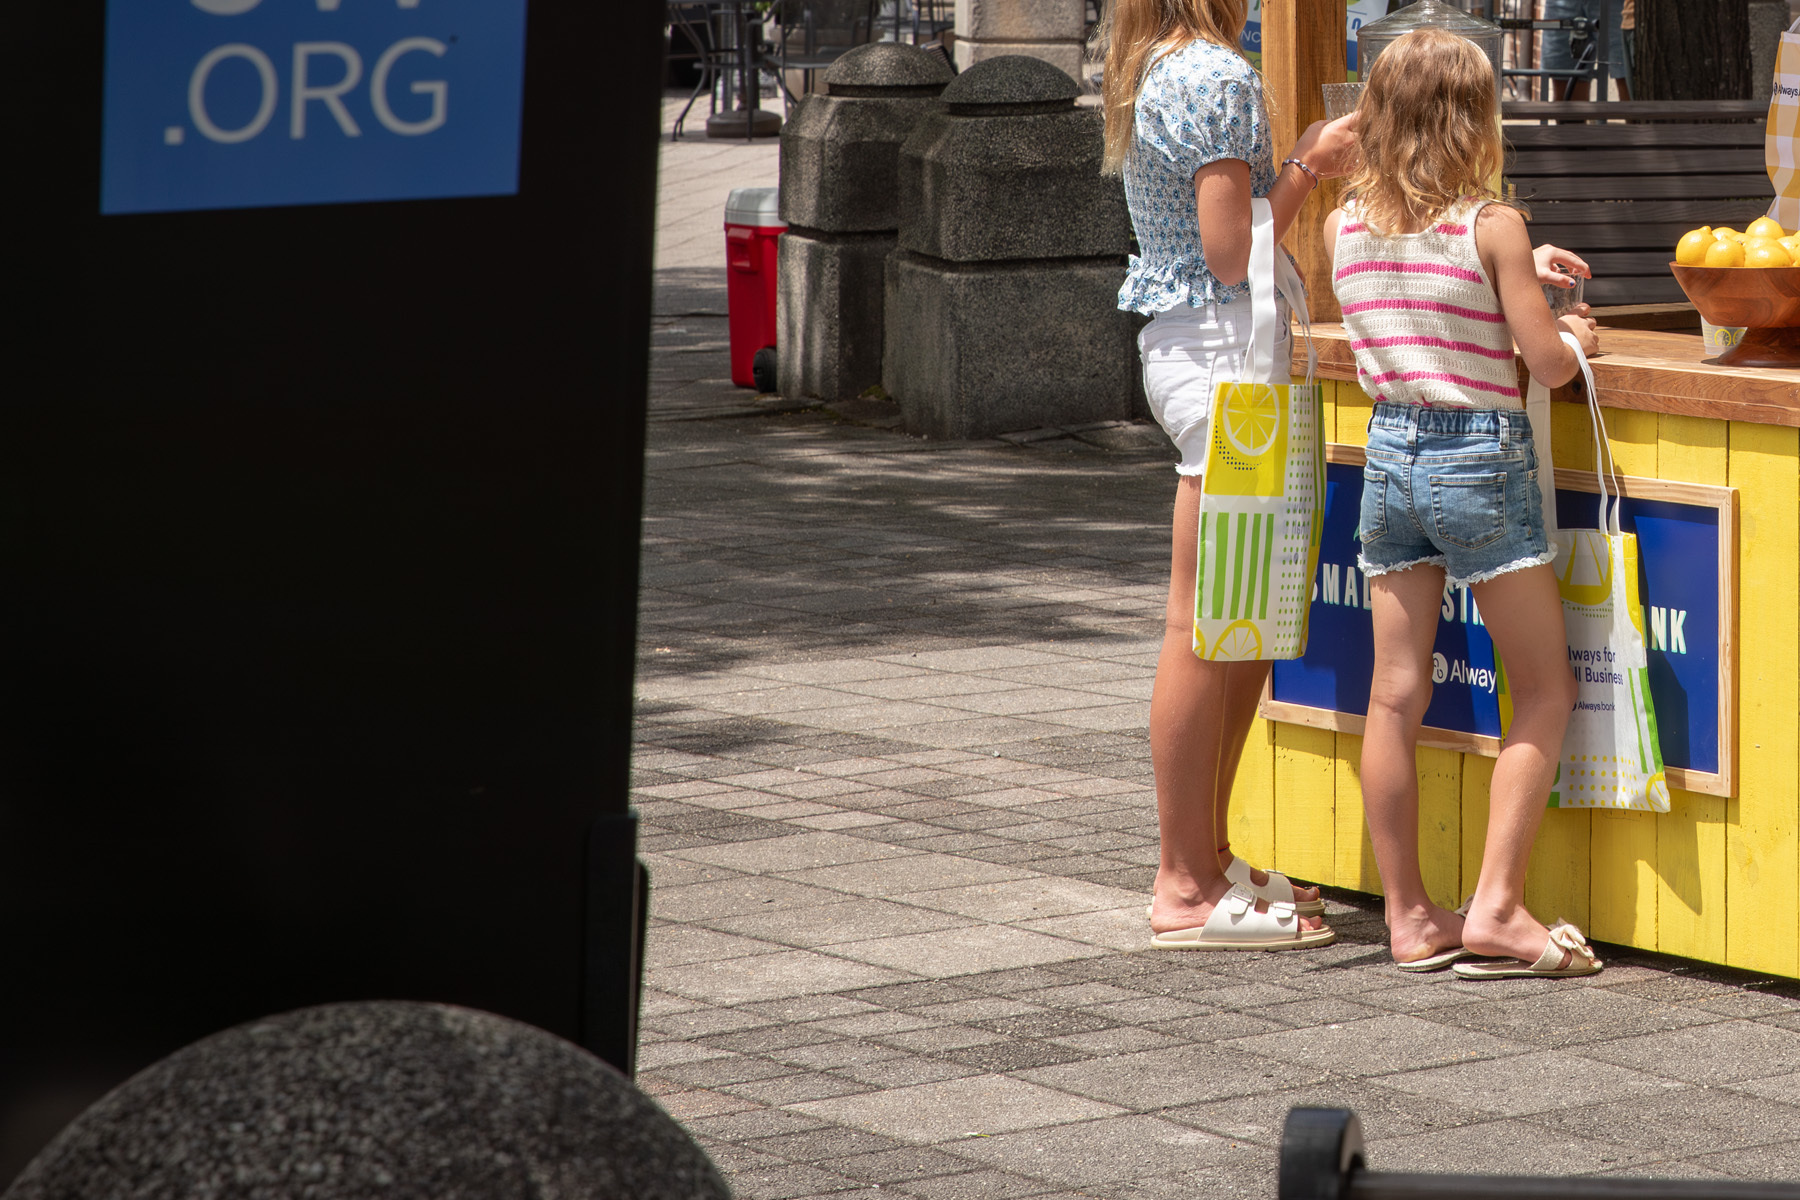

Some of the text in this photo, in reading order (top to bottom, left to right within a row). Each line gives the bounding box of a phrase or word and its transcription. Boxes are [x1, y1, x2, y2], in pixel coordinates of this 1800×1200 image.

[164, 36, 449, 145] .ORG
[1568, 645, 1616, 665] lways for
